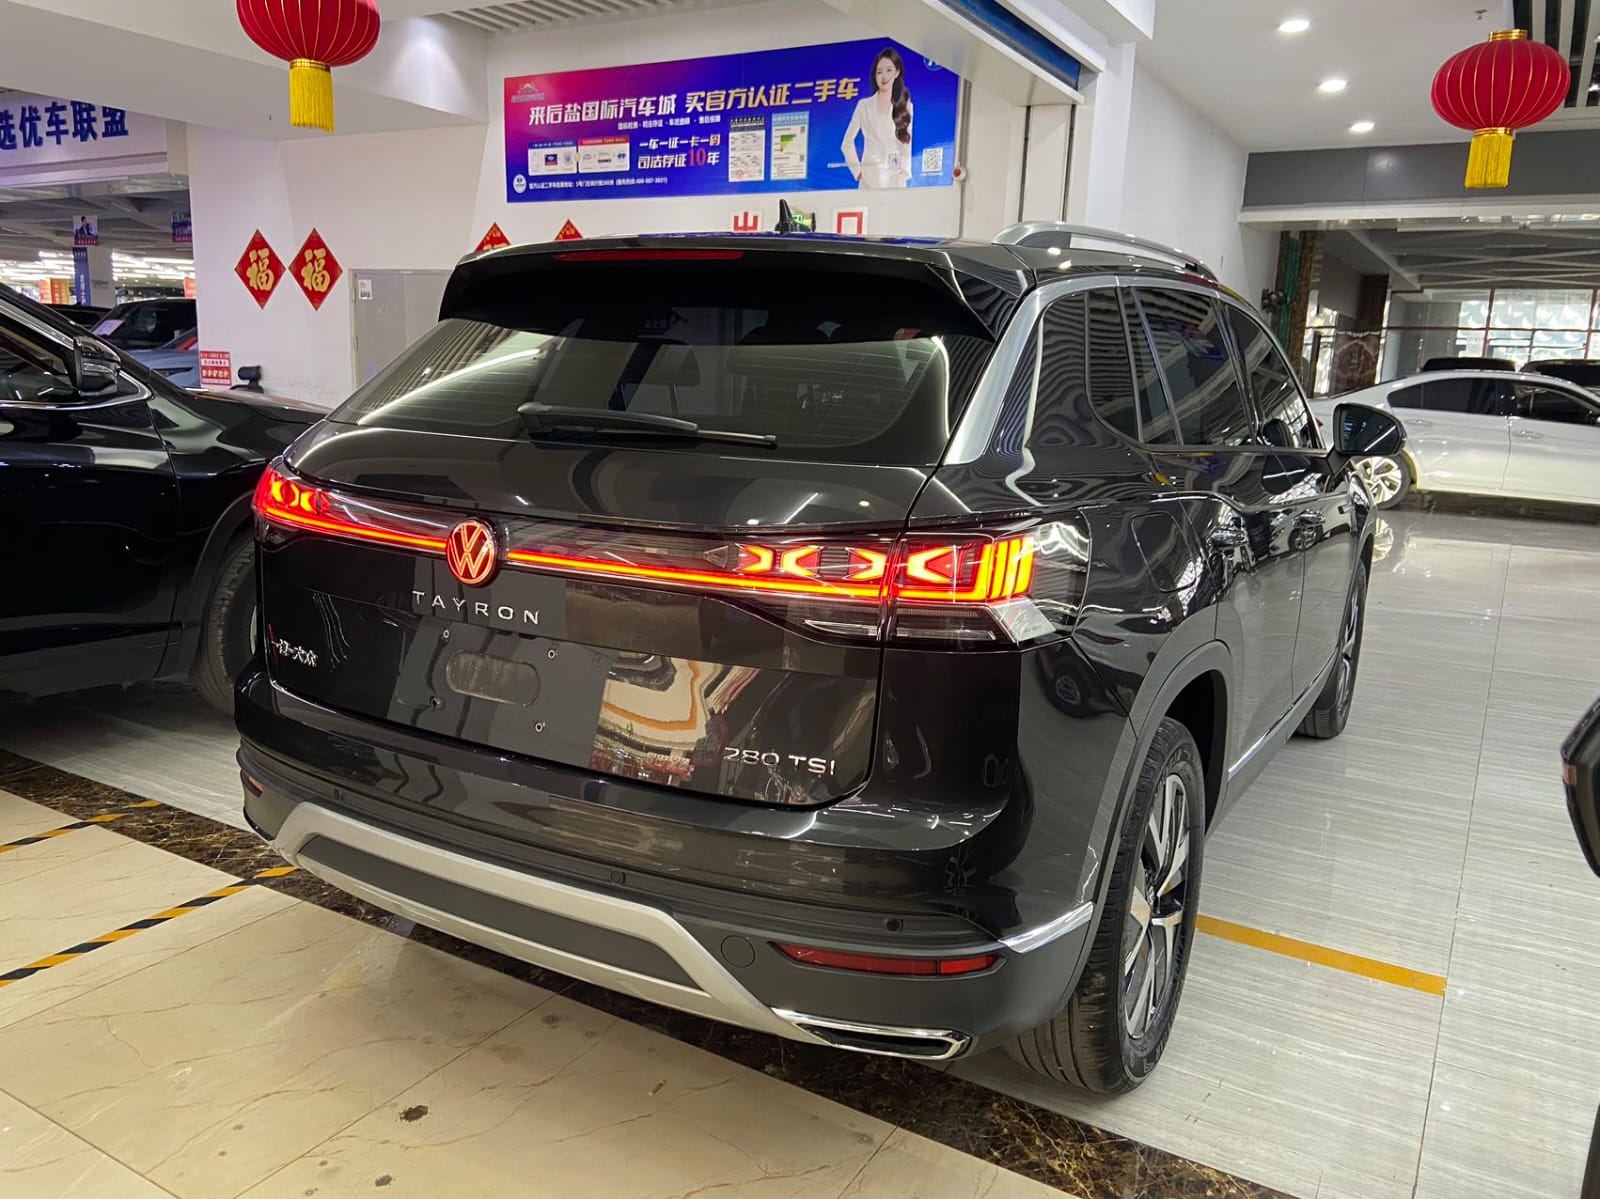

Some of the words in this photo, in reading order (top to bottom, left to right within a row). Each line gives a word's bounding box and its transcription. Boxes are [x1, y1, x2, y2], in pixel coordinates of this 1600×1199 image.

[529, 94, 677, 126] 来后盐国际汽车城
[685, 78, 861, 113] 买官方认证二手车
[0, 101, 129, 150] 选优车联盟
[246, 247, 275, 292] 福
[301, 247, 331, 293] 福
[412, 590, 541, 625] TAYRON
[723, 746, 780, 767] 280
[788, 754, 836, 776] TSI
